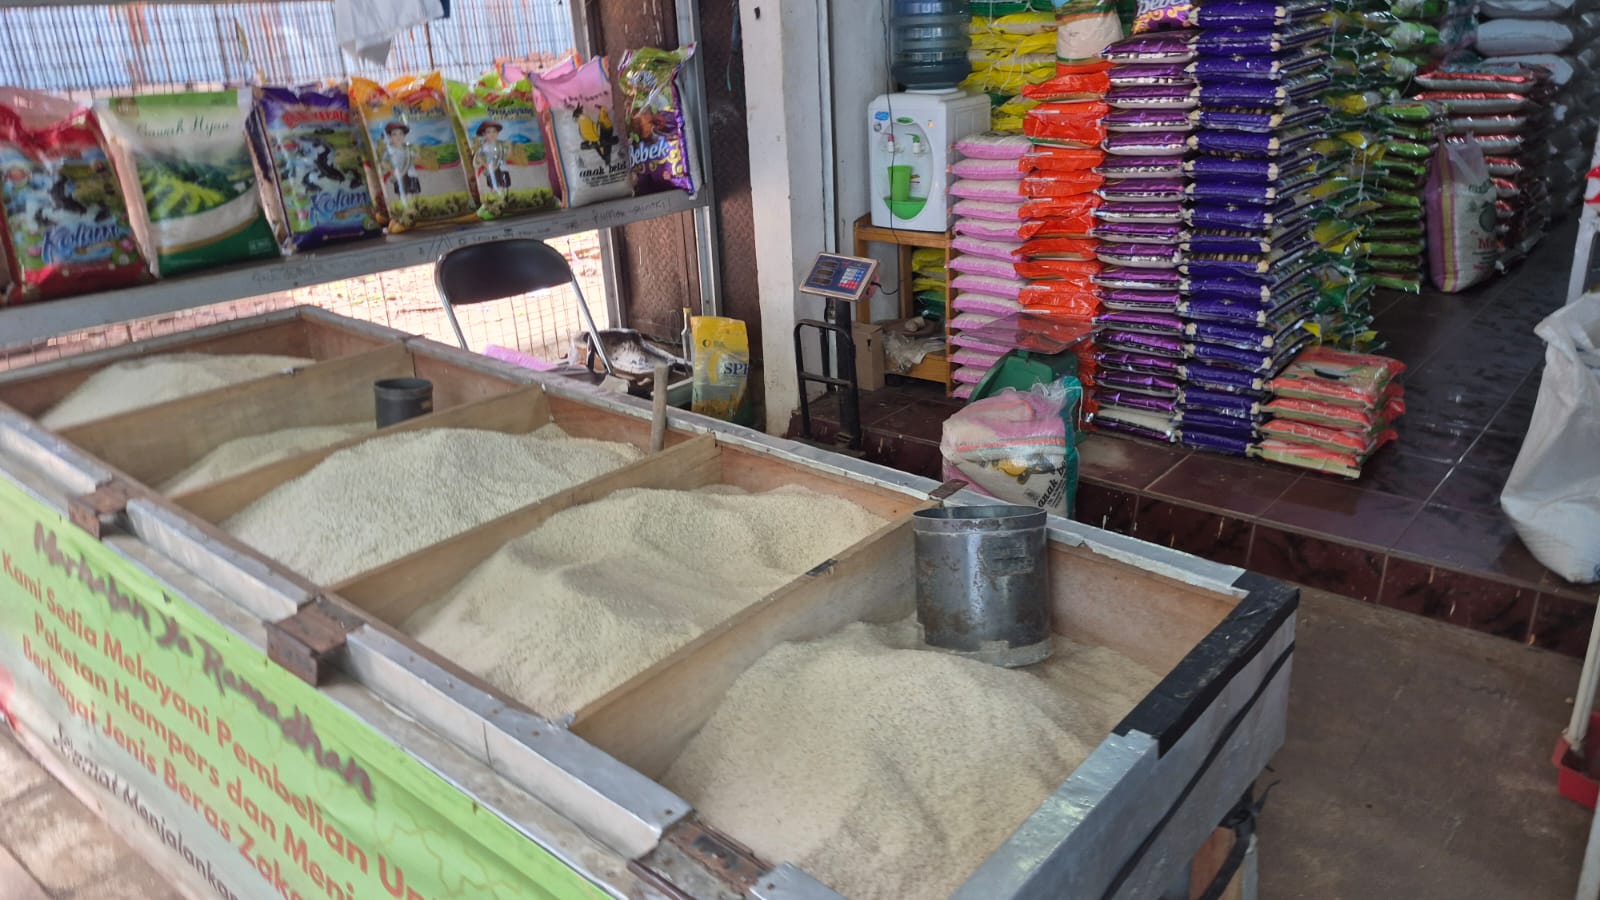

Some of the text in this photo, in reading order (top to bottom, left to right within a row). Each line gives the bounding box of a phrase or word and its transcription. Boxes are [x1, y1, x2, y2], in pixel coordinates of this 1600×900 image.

[3, 548, 43, 604] Kami
[47, 586, 97, 648] Sedia
[103, 630, 210, 736] Melayani
[216, 716, 368, 876] Pembelian
[23, 634, 97, 726] Berbagai
[102, 711, 157, 776] Jenis
[164, 757, 231, 842] Beras
[35, 610, 108, 696] Paketan
[114, 678, 220, 789] Hampers
[227, 775, 276, 842] dan
